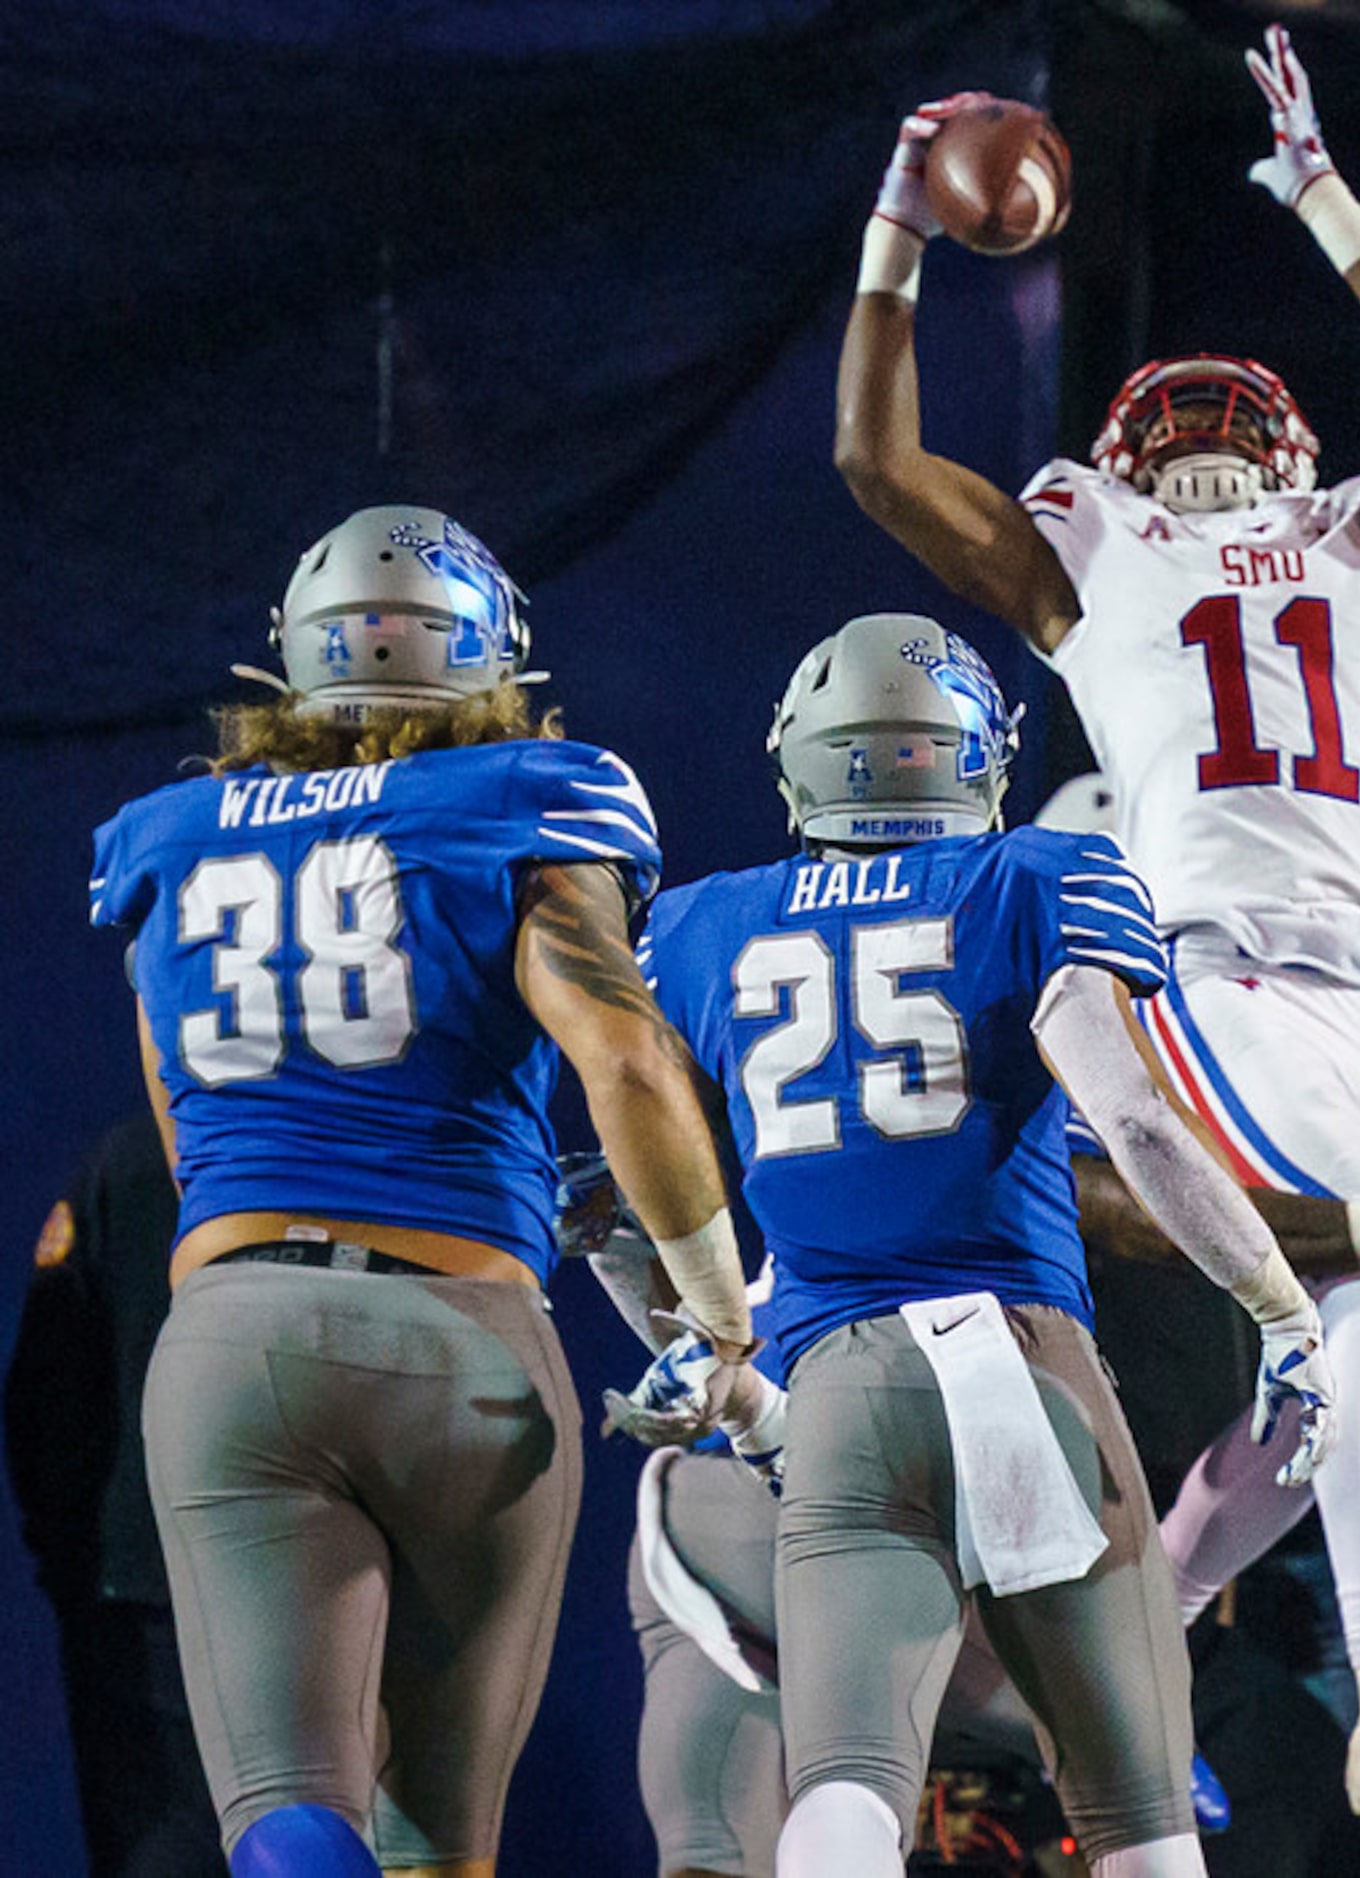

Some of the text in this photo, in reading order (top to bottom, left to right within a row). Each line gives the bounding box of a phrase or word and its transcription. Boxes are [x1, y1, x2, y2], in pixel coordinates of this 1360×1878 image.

[1219, 543, 1305, 586] SMU
[1179, 595, 1360, 804] 11
[218, 761, 393, 828] WILSON
[852, 820, 945, 835] MEMPHIS
[788, 855, 911, 914] HALL
[177, 834, 418, 1088] 38
[732, 916, 972, 1158] 25
